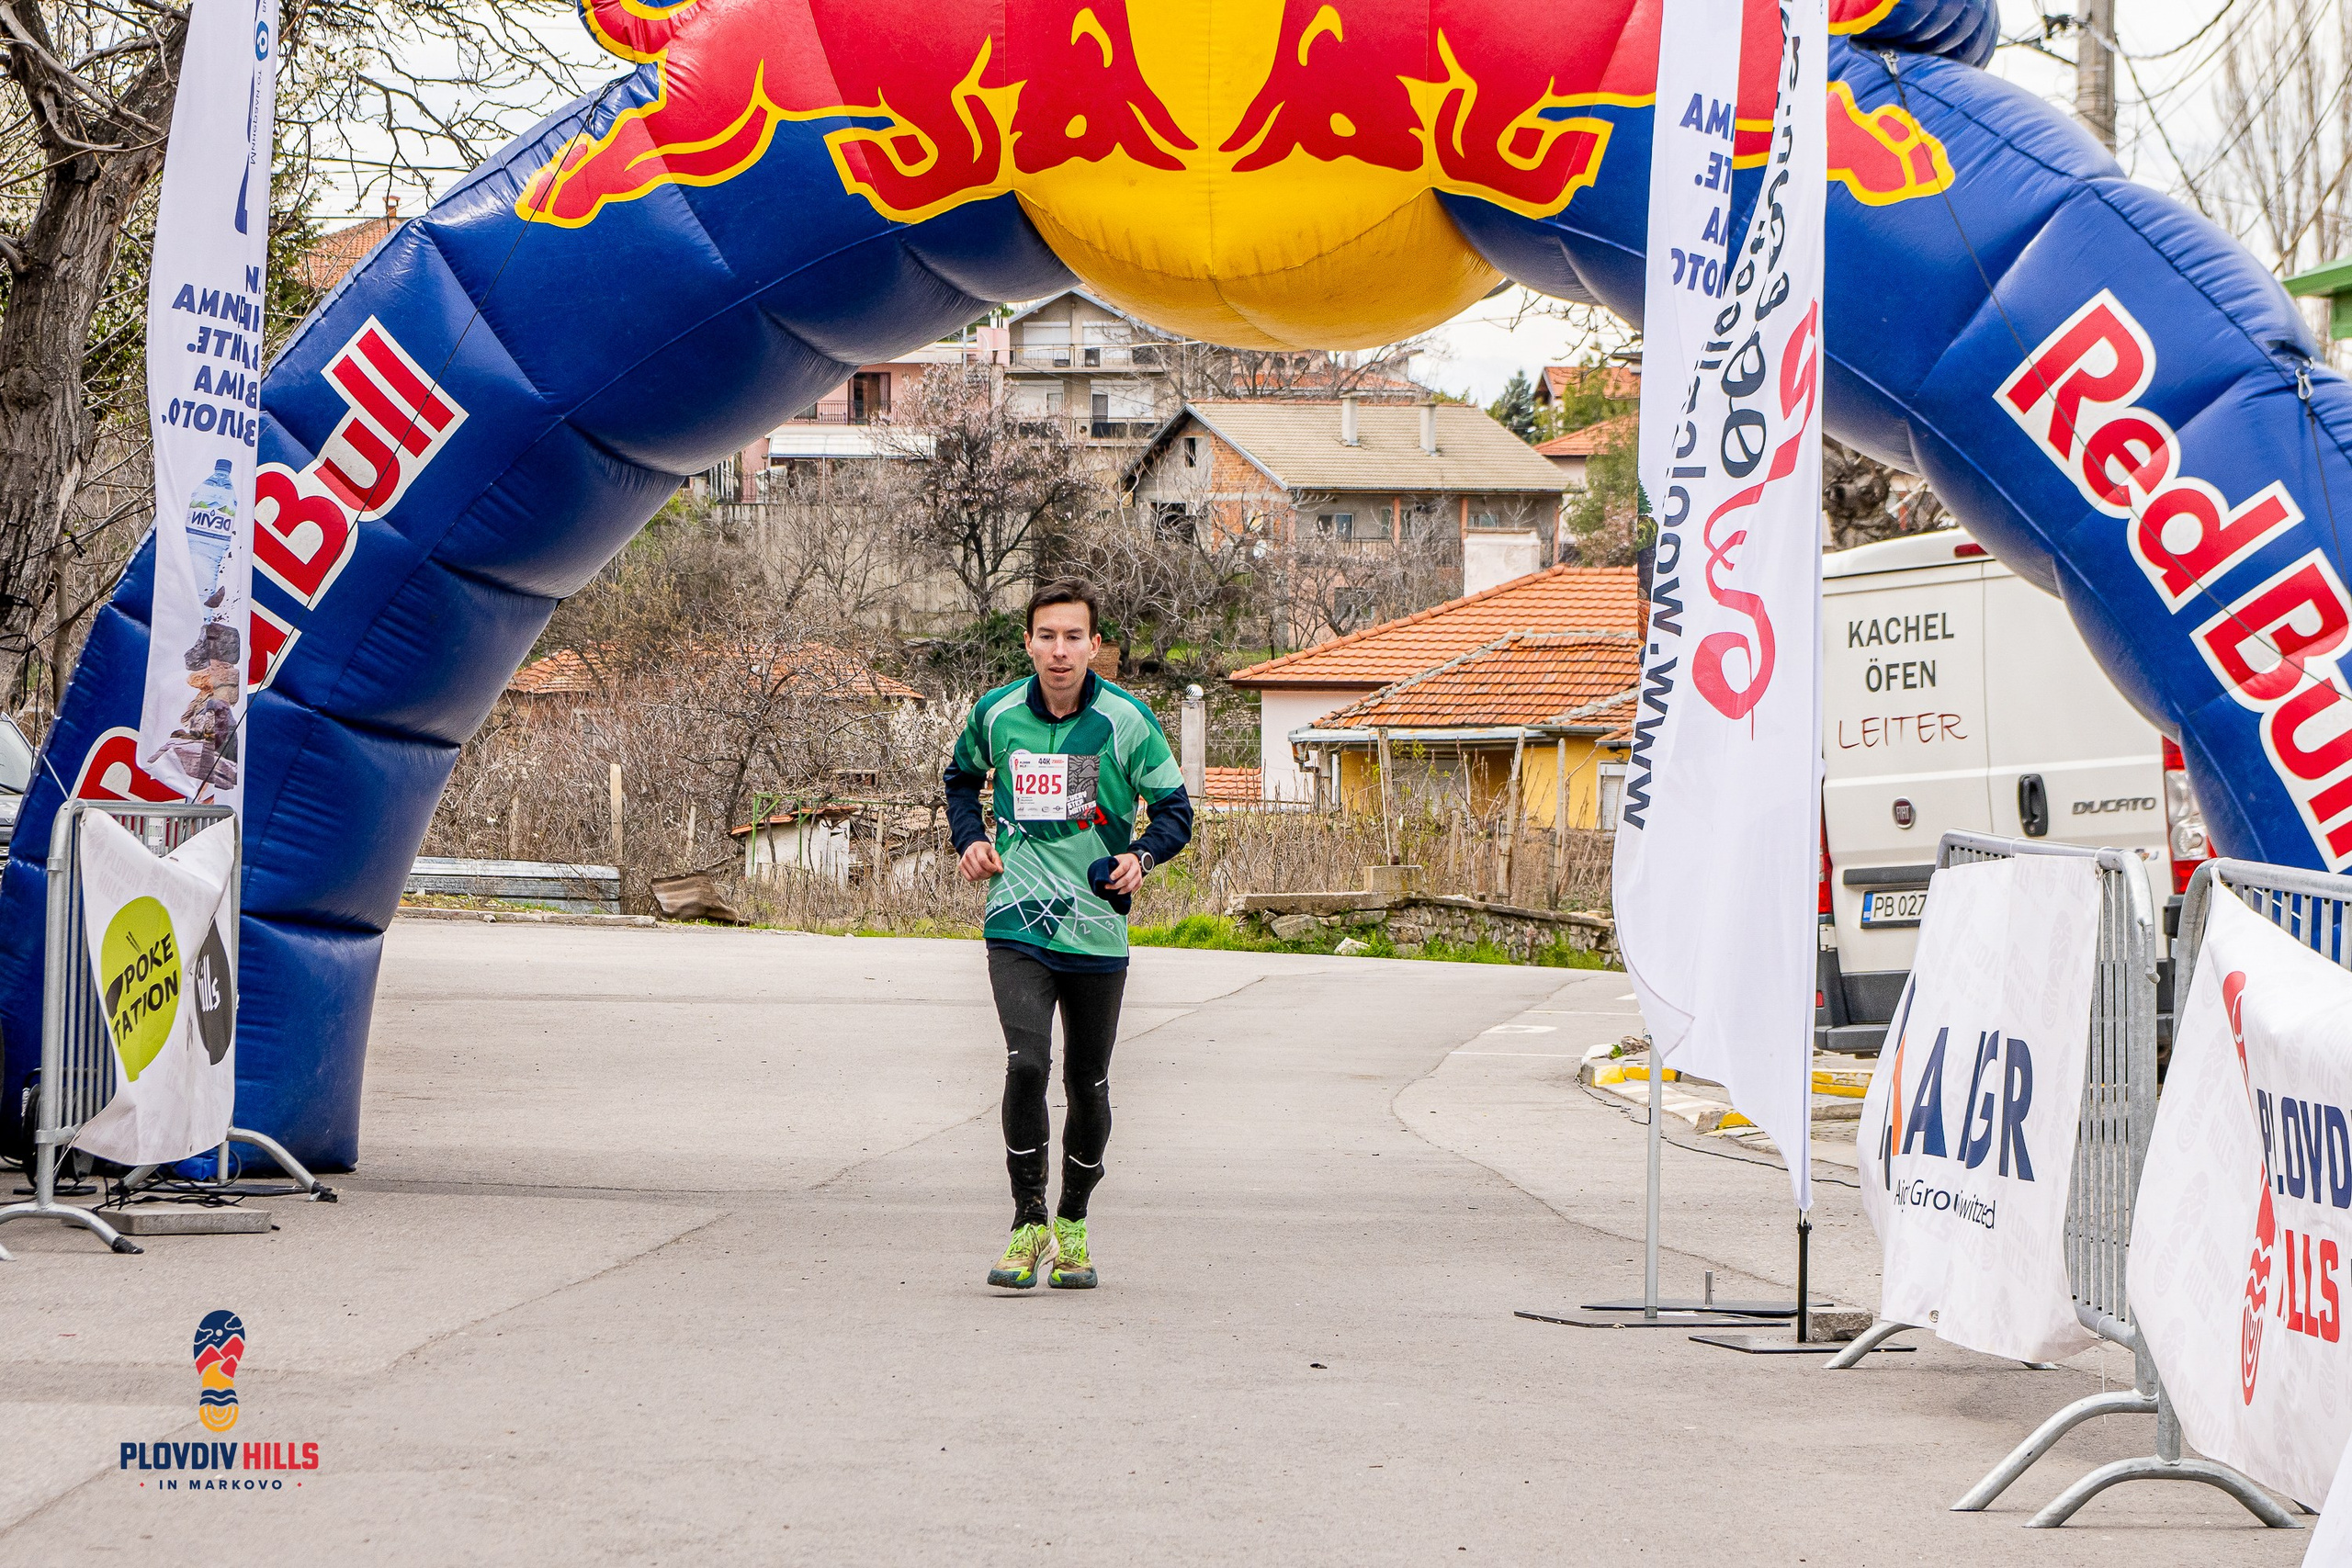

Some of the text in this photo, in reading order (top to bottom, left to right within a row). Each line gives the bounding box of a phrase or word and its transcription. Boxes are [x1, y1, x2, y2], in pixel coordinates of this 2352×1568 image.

[253, 325, 457, 599] Bull
[2007, 304, 2289, 600] Red
[1848, 612, 1955, 649] KACHEL
[1865, 658, 1937, 693] ÖFEN
[1838, 712, 1968, 749] LEITER
[1015, 773, 1062, 795] 4285
[1895, 805, 1910, 820] FIAT
[2072, 796, 2156, 816] DUCATO
[1873, 896, 1894, 919] PB
[121, 931, 175, 994] POKE
